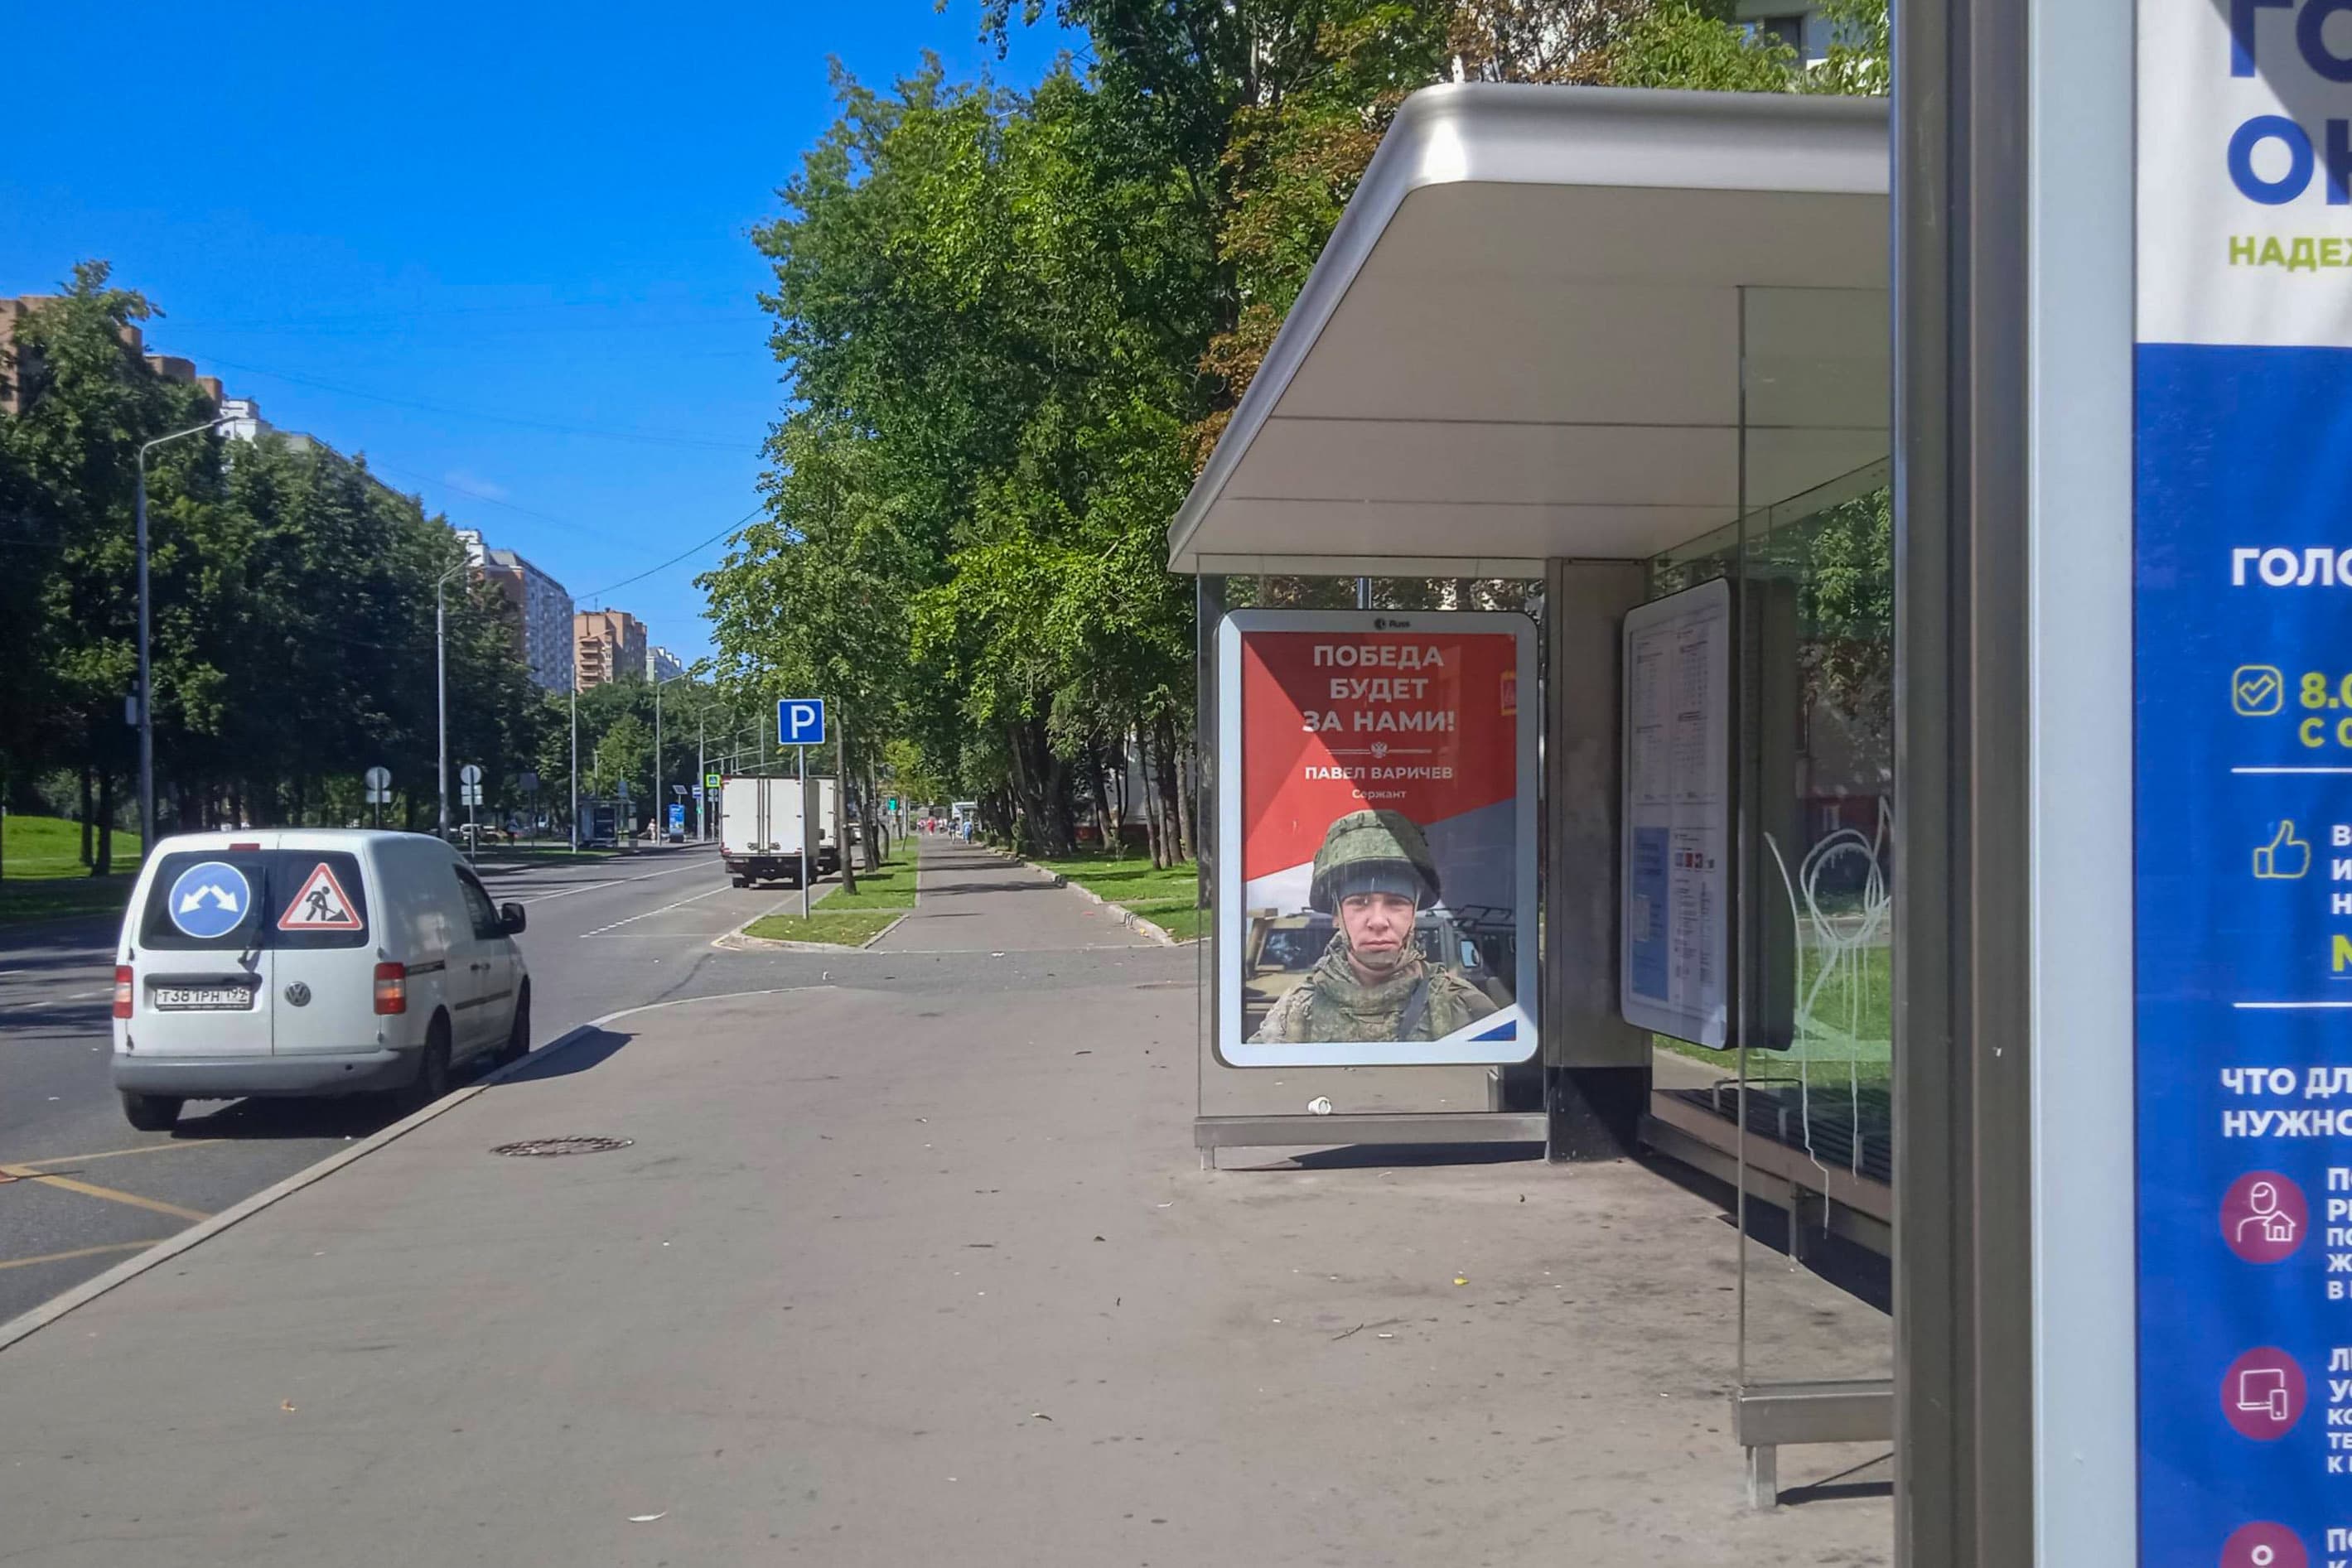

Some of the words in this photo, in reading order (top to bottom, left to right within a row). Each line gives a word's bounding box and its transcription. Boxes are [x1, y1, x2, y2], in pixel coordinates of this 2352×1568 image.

[2229, 235, 2352, 273] НАДЕ
[1313, 644, 1445, 671] ПОБЕДА
[1330, 678, 1430, 703] БУДЕТ
[790, 705, 816, 740] P
[1302, 710, 1344, 732] ЗА
[1354, 710, 1456, 732] НАМИ!
[1305, 765, 1365, 780] ПАВЕЛ
[1371, 766, 1454, 780] ВАРИЧЕВ
[1351, 788, 1408, 800] Сержант
[2221, 1067, 2296, 1095] ЧТО
